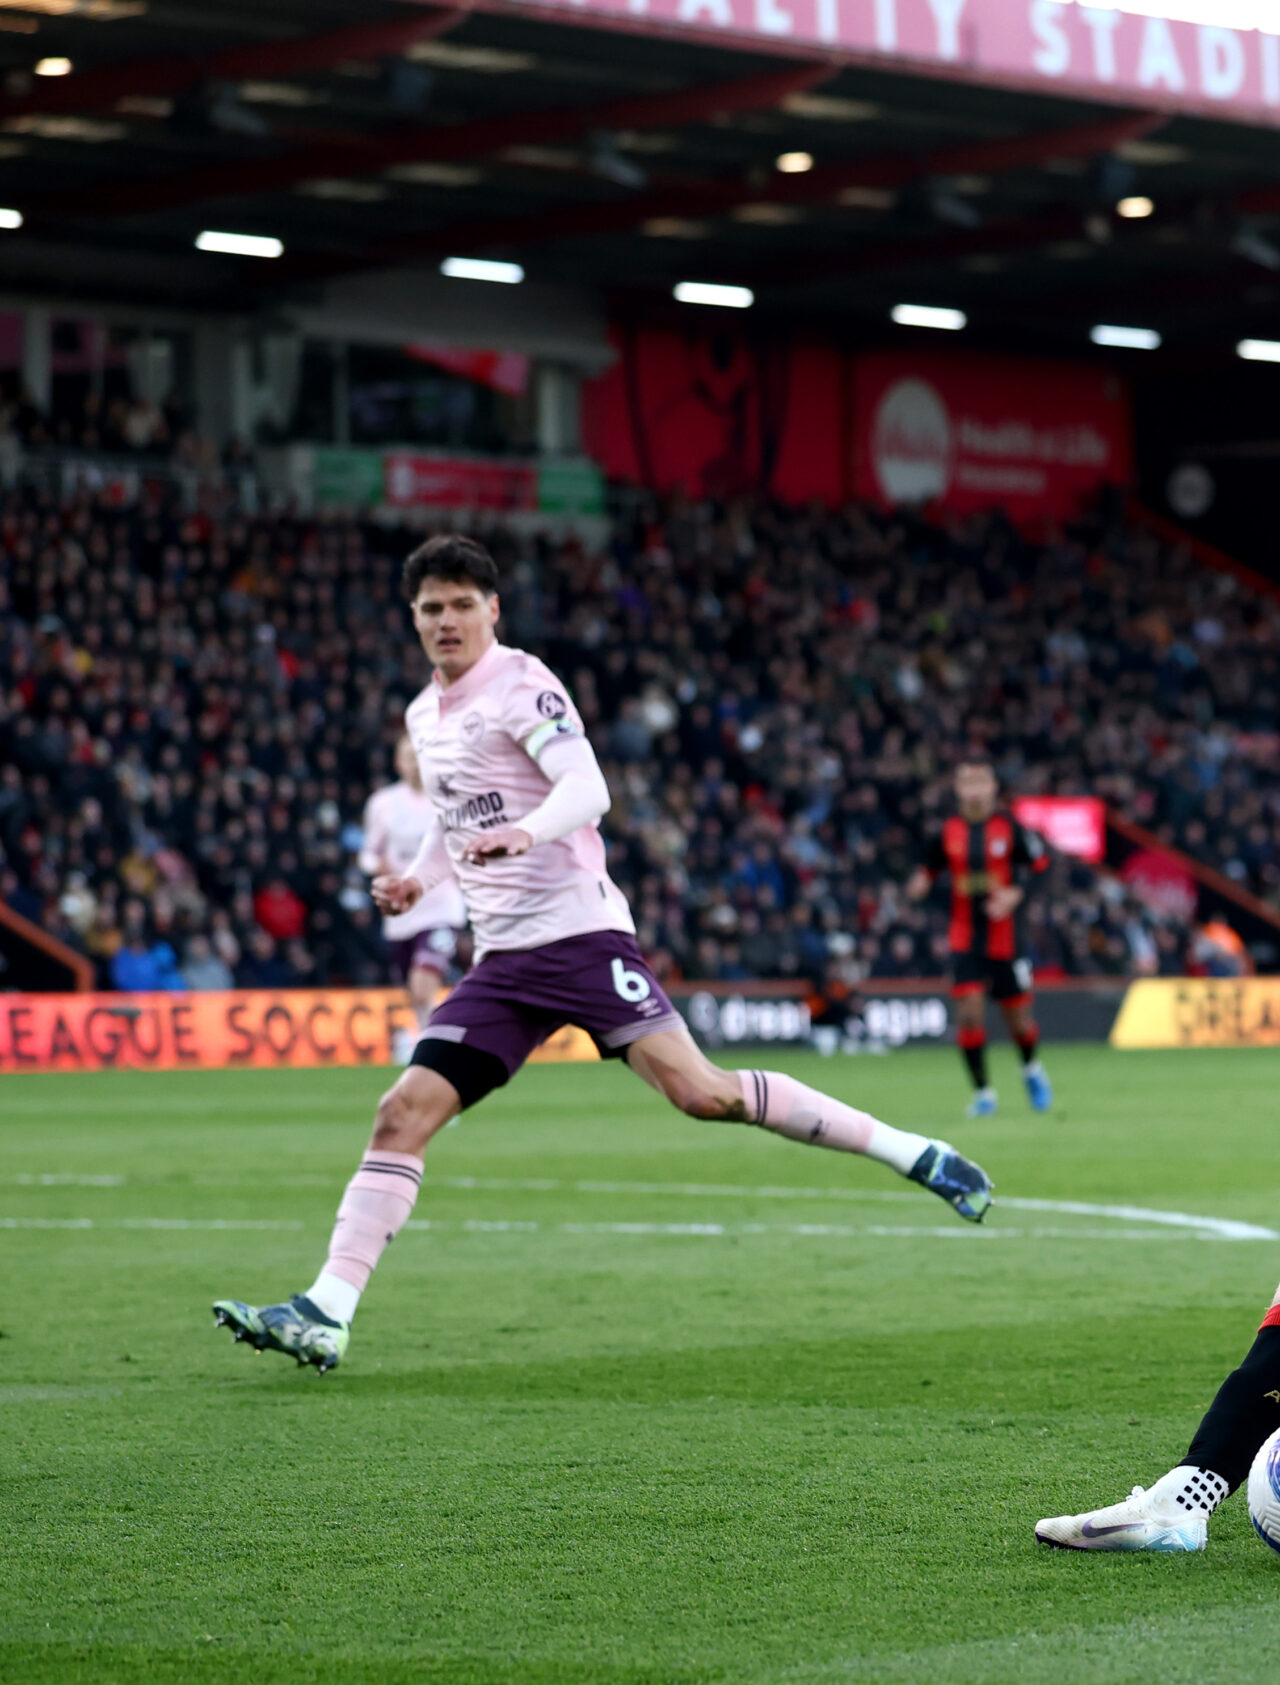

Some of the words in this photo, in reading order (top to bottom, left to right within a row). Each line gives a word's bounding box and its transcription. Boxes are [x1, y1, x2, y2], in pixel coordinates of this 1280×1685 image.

[611, 957, 650, 1002] 6
[2, 1005, 199, 1063] EAGUE
[226, 1003, 407, 1059] SOCCE
